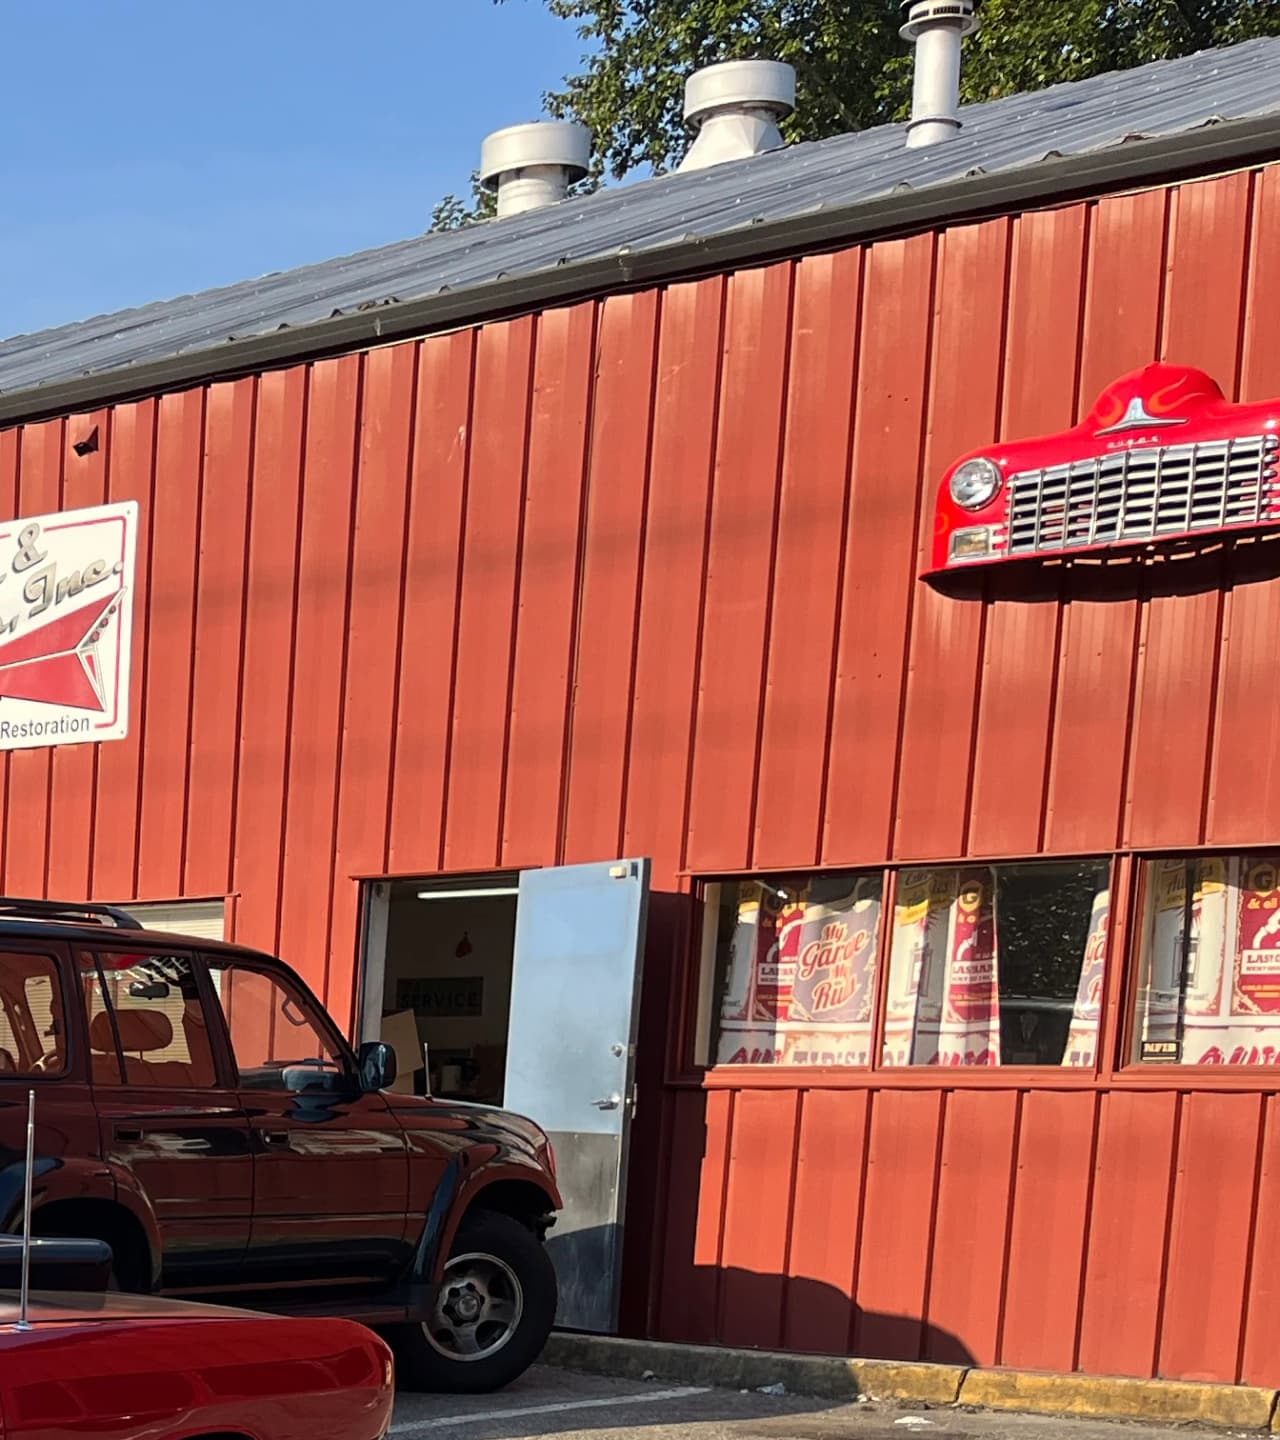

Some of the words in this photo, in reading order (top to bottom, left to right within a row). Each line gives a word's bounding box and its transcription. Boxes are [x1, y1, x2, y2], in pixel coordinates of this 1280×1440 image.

[12, 523, 48, 573] &
[23, 560, 124, 620] Inc.
[0, 717, 90, 740] Restoration
[823, 924, 844, 942] My
